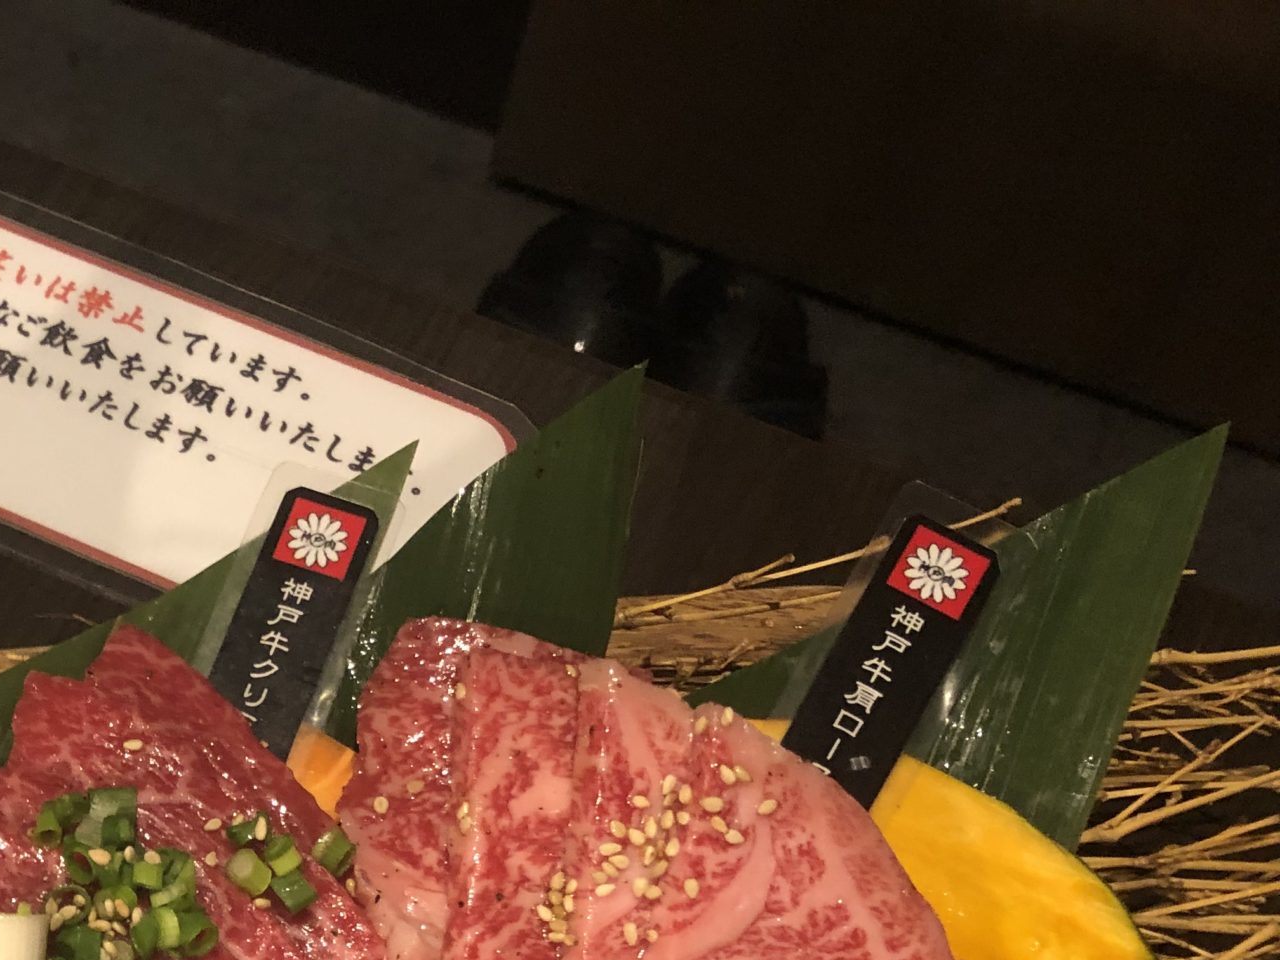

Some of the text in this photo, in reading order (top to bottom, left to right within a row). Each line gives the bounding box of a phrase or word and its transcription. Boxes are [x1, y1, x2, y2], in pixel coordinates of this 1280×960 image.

[241, 577, 314, 724] 神戸牛クリ
